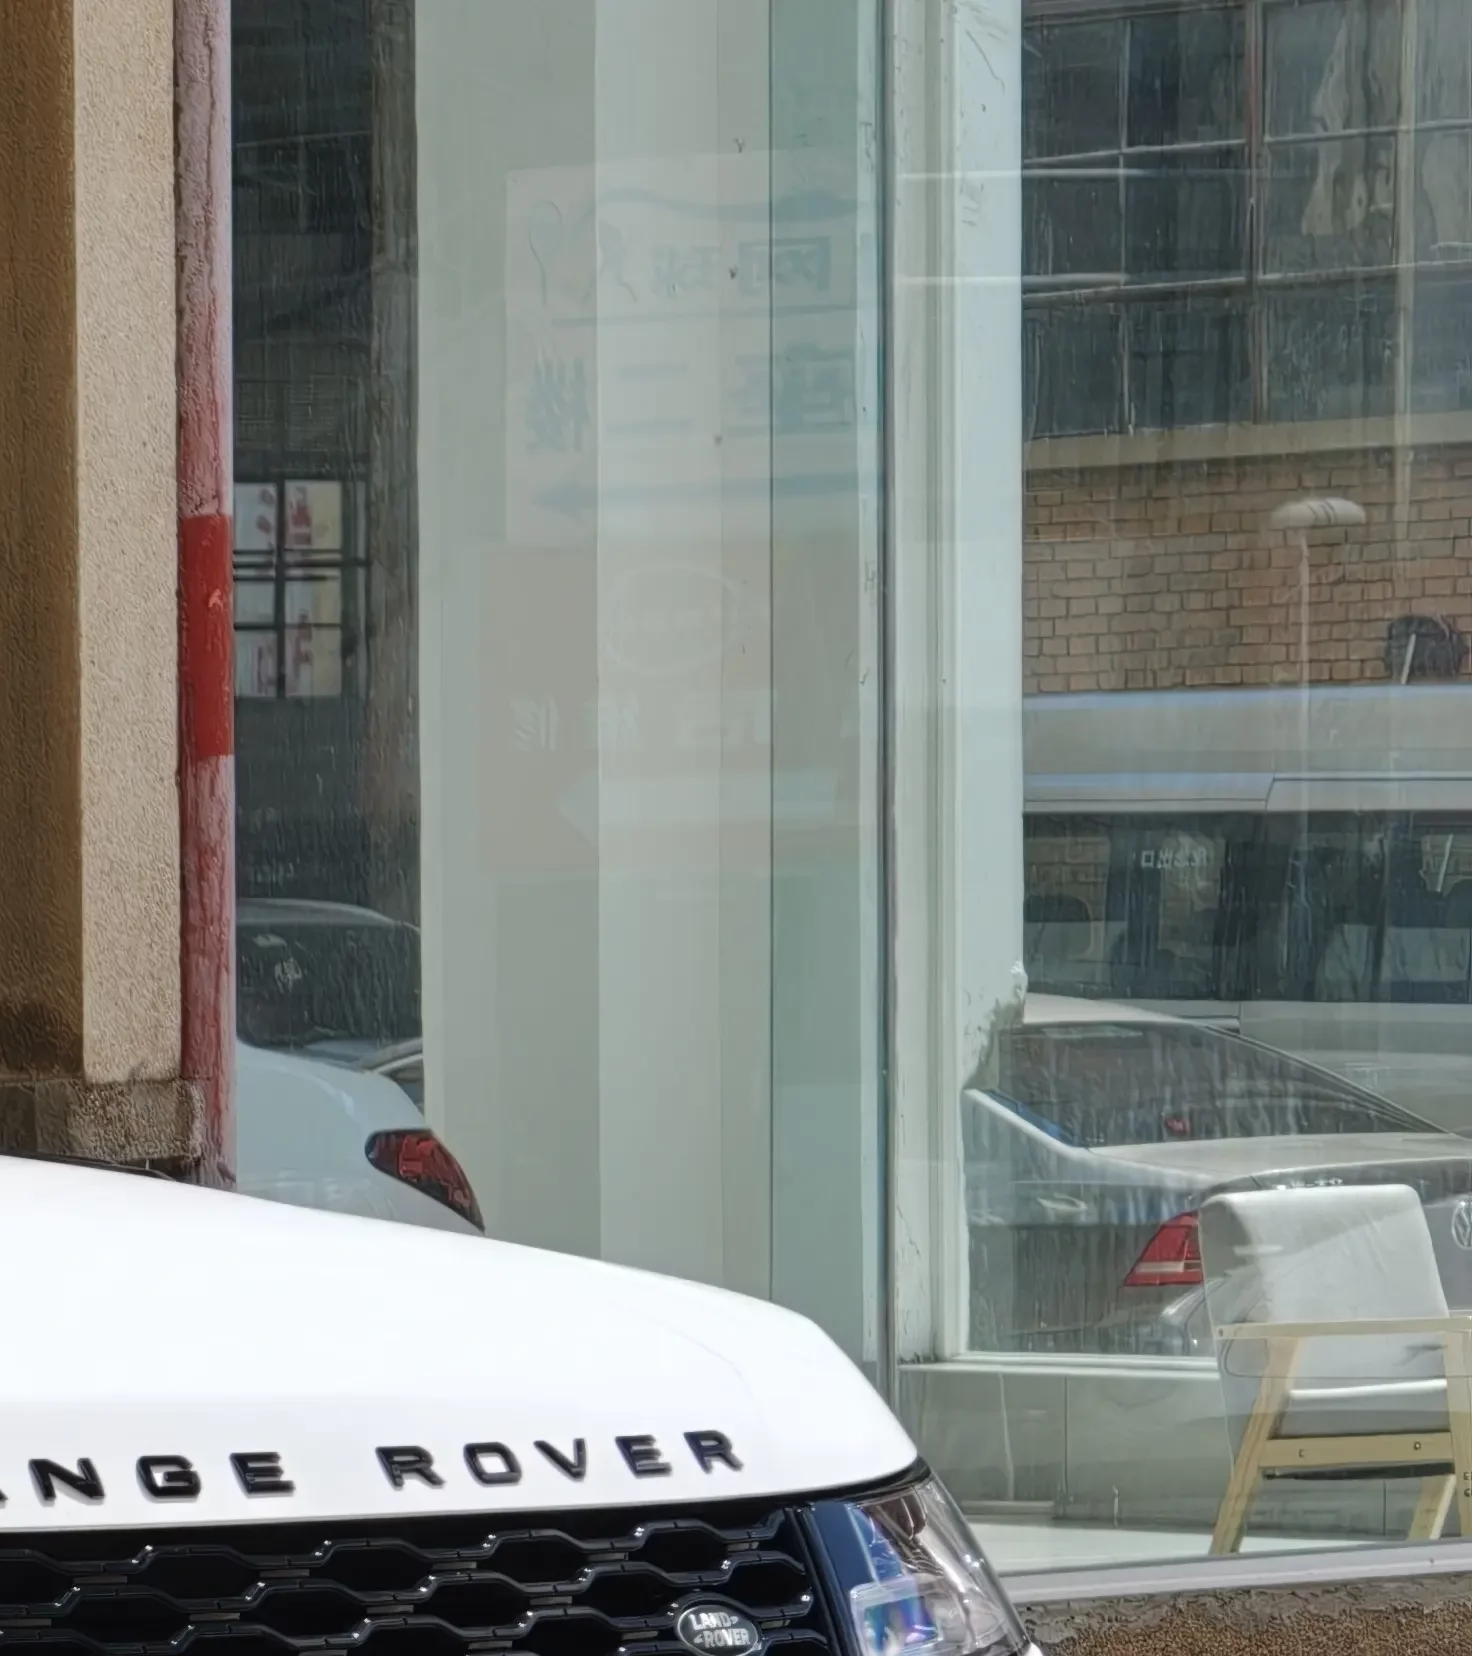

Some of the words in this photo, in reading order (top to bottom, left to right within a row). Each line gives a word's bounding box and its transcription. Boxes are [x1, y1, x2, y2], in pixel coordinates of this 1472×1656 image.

[376, 1429, 743, 1490] ROVER
[688, 1612, 732, 1630] LAND
[702, 1628, 751, 1648] ROVER
